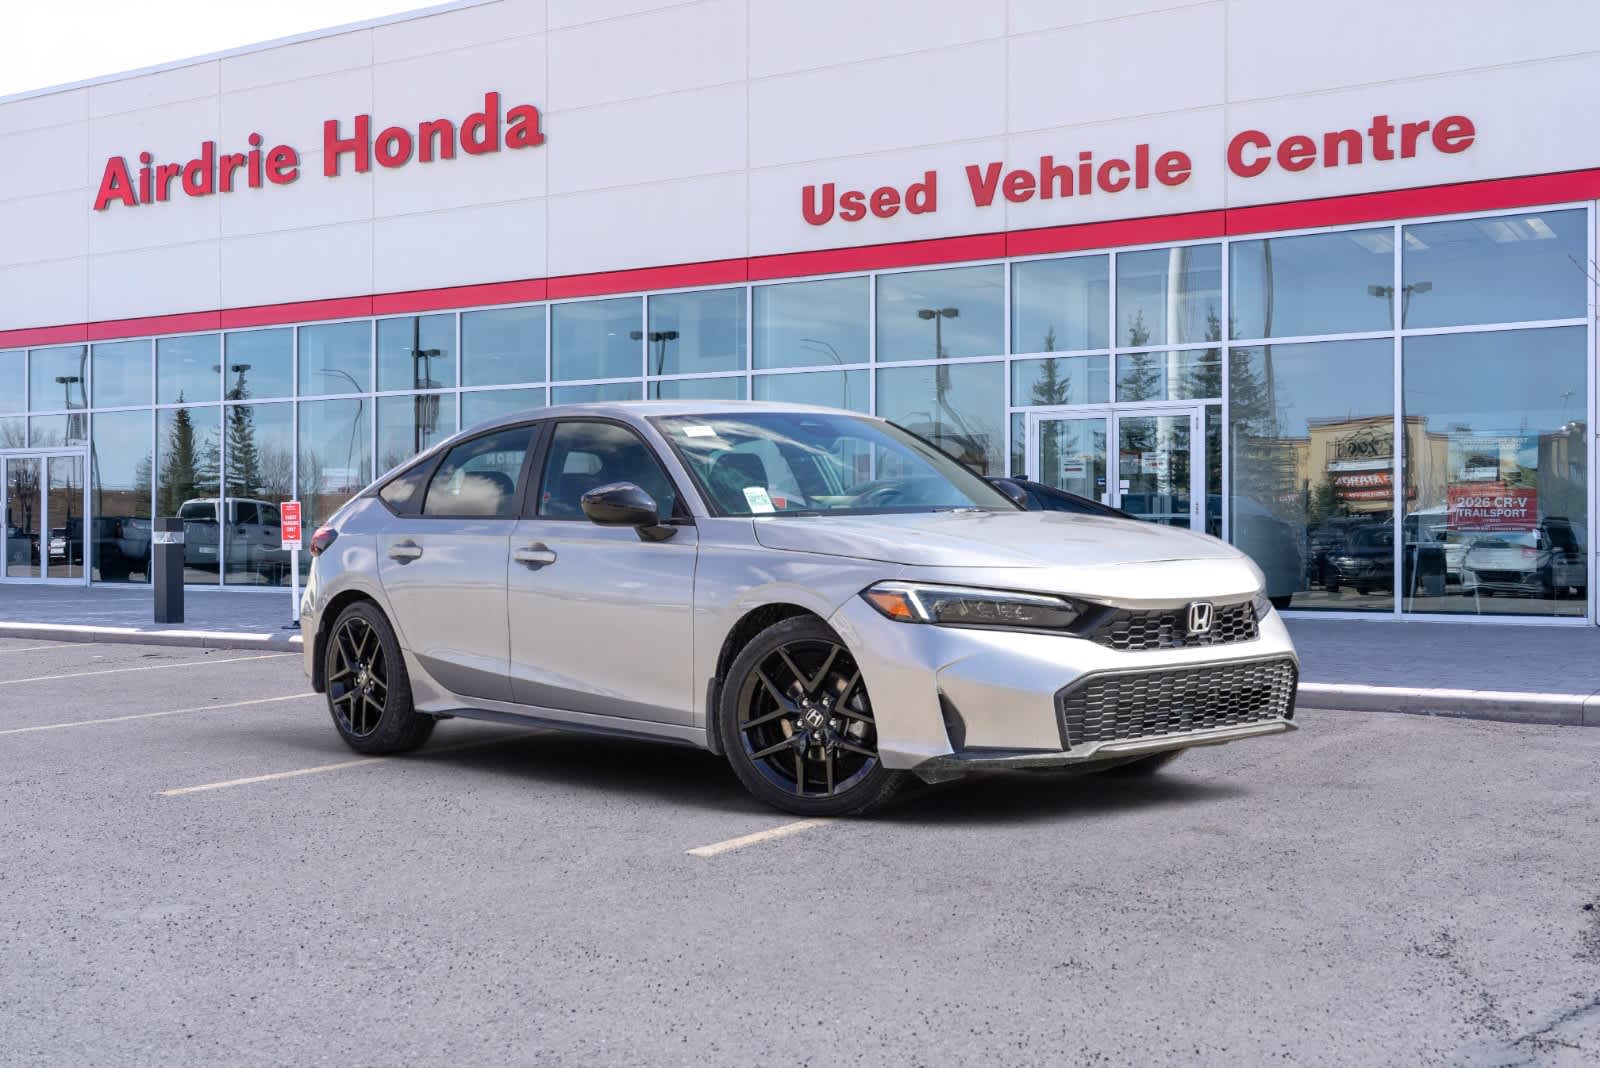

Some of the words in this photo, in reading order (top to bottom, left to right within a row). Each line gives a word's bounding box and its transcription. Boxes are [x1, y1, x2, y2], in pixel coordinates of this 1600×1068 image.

[94, 132, 298, 211] Airdrie
[324, 92, 545, 177] Honda
[802, 170, 937, 226] Used
[965, 143, 1192, 207] Vehicle
[1227, 115, 1476, 178] Centre
[1457, 497, 1490, 508] 2026
[1494, 496, 1528, 508] CR-V
[1457, 508, 1528, 518] TRAILSPORT
